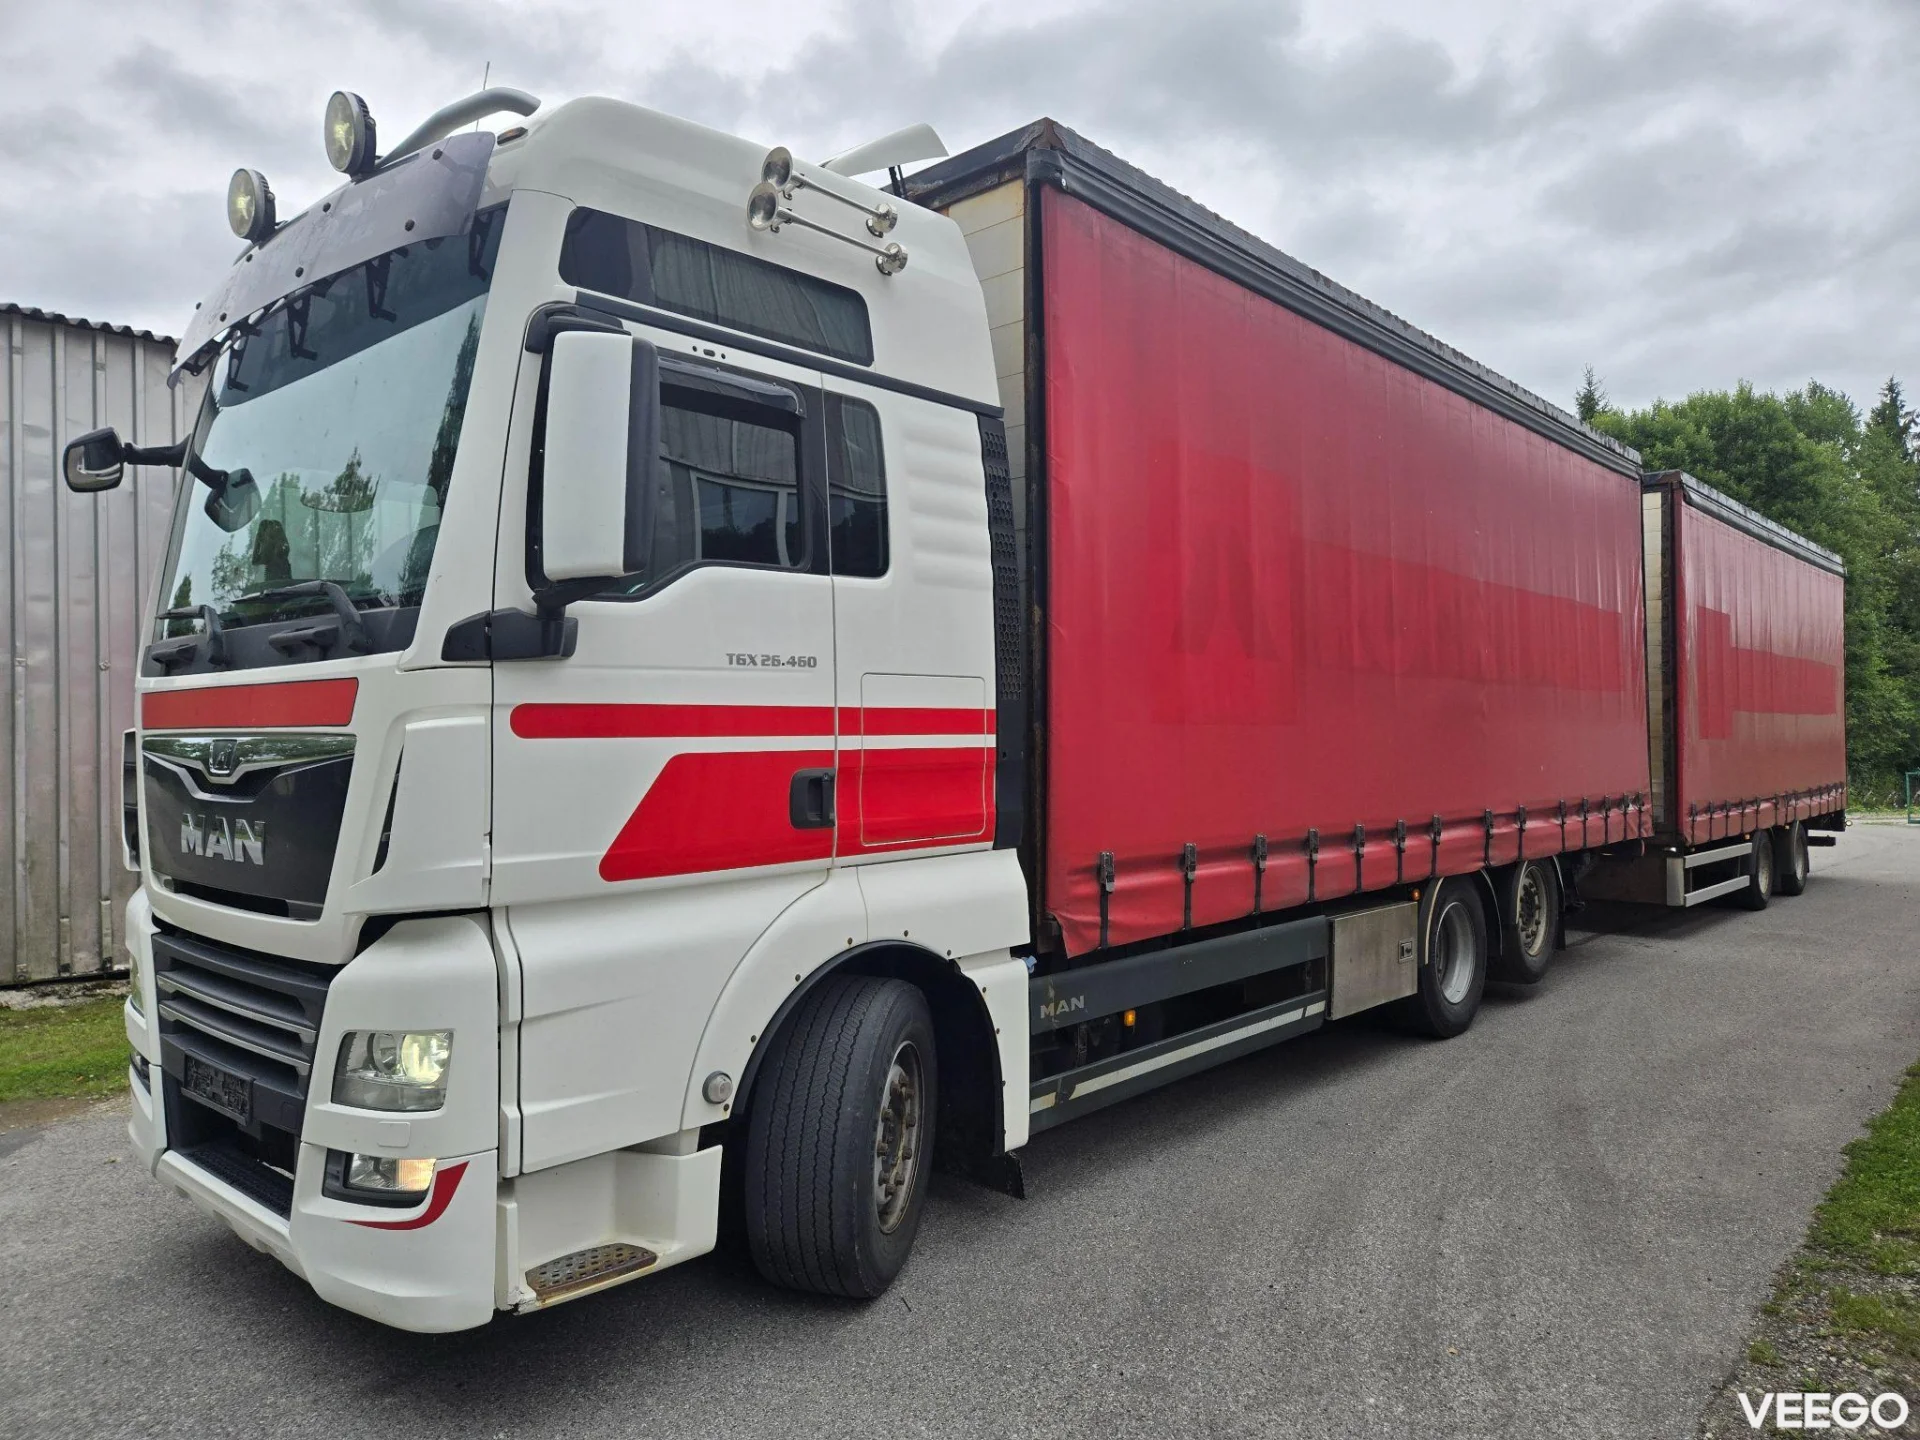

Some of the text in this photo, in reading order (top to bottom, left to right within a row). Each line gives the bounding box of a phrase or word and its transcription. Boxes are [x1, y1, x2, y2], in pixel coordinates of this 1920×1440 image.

[726, 653, 817, 668] TGX 26.460
[181, 812, 265, 866] MAN
[1040, 995, 1085, 1019] MAN
